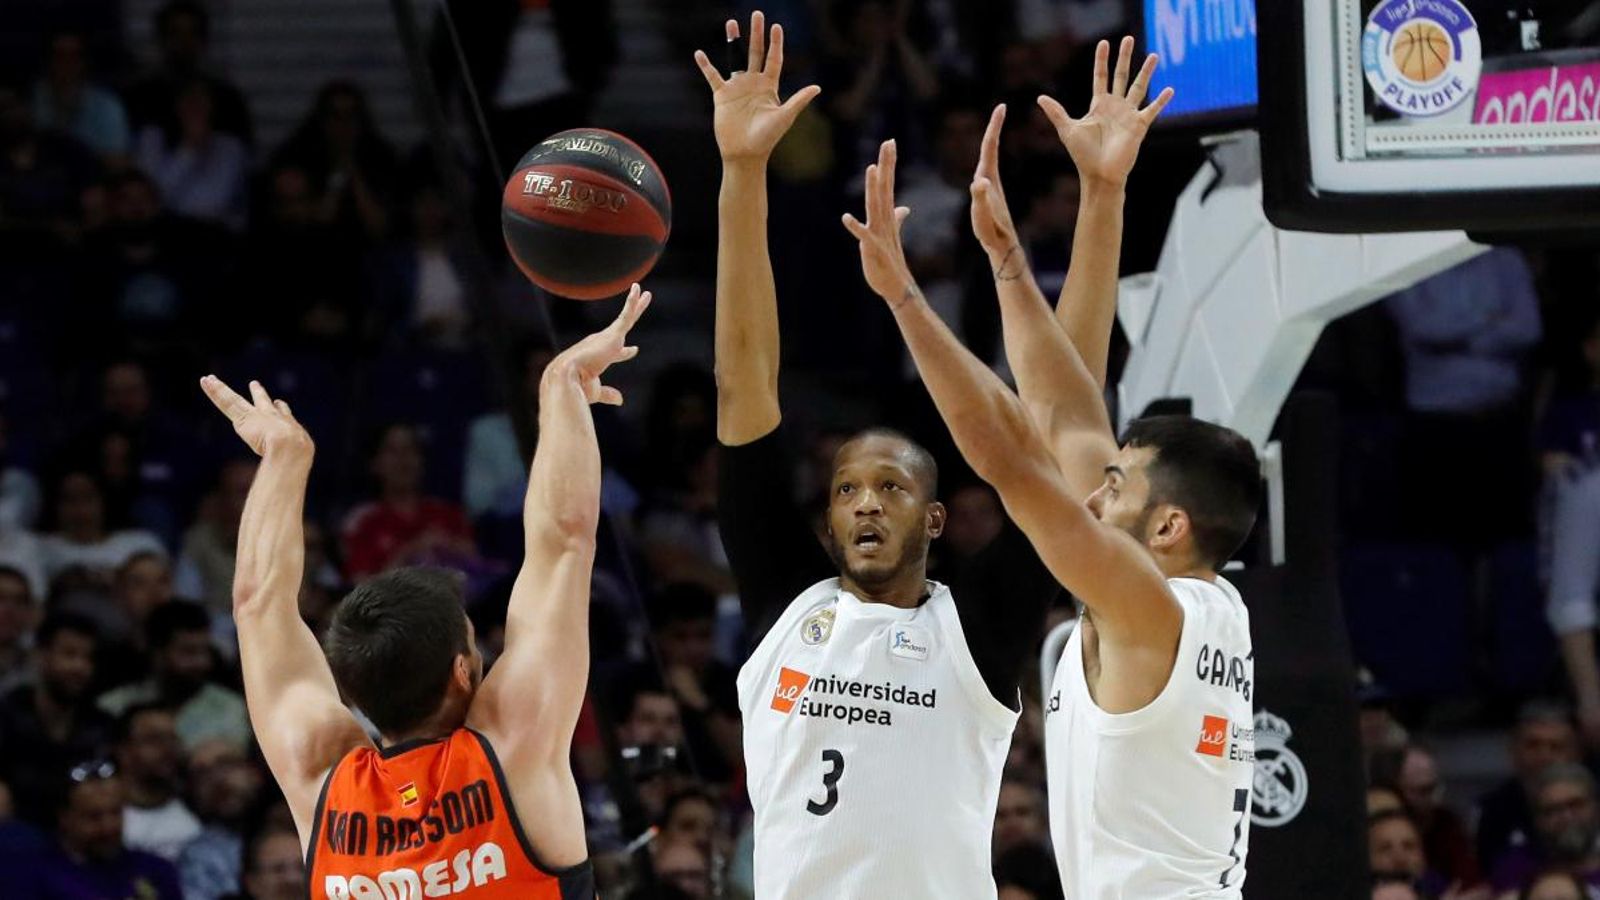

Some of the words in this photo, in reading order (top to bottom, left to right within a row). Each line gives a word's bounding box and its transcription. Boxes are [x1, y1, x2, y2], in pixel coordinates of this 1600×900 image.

[1384, 78, 1463, 109] PLAYOFF
[809, 674, 937, 709] niversidad
[806, 749, 845, 816] 3
[327, 809, 368, 856] VAN
[376, 779, 495, 857] ROSSOM
[325, 842, 507, 900] PAMESA
